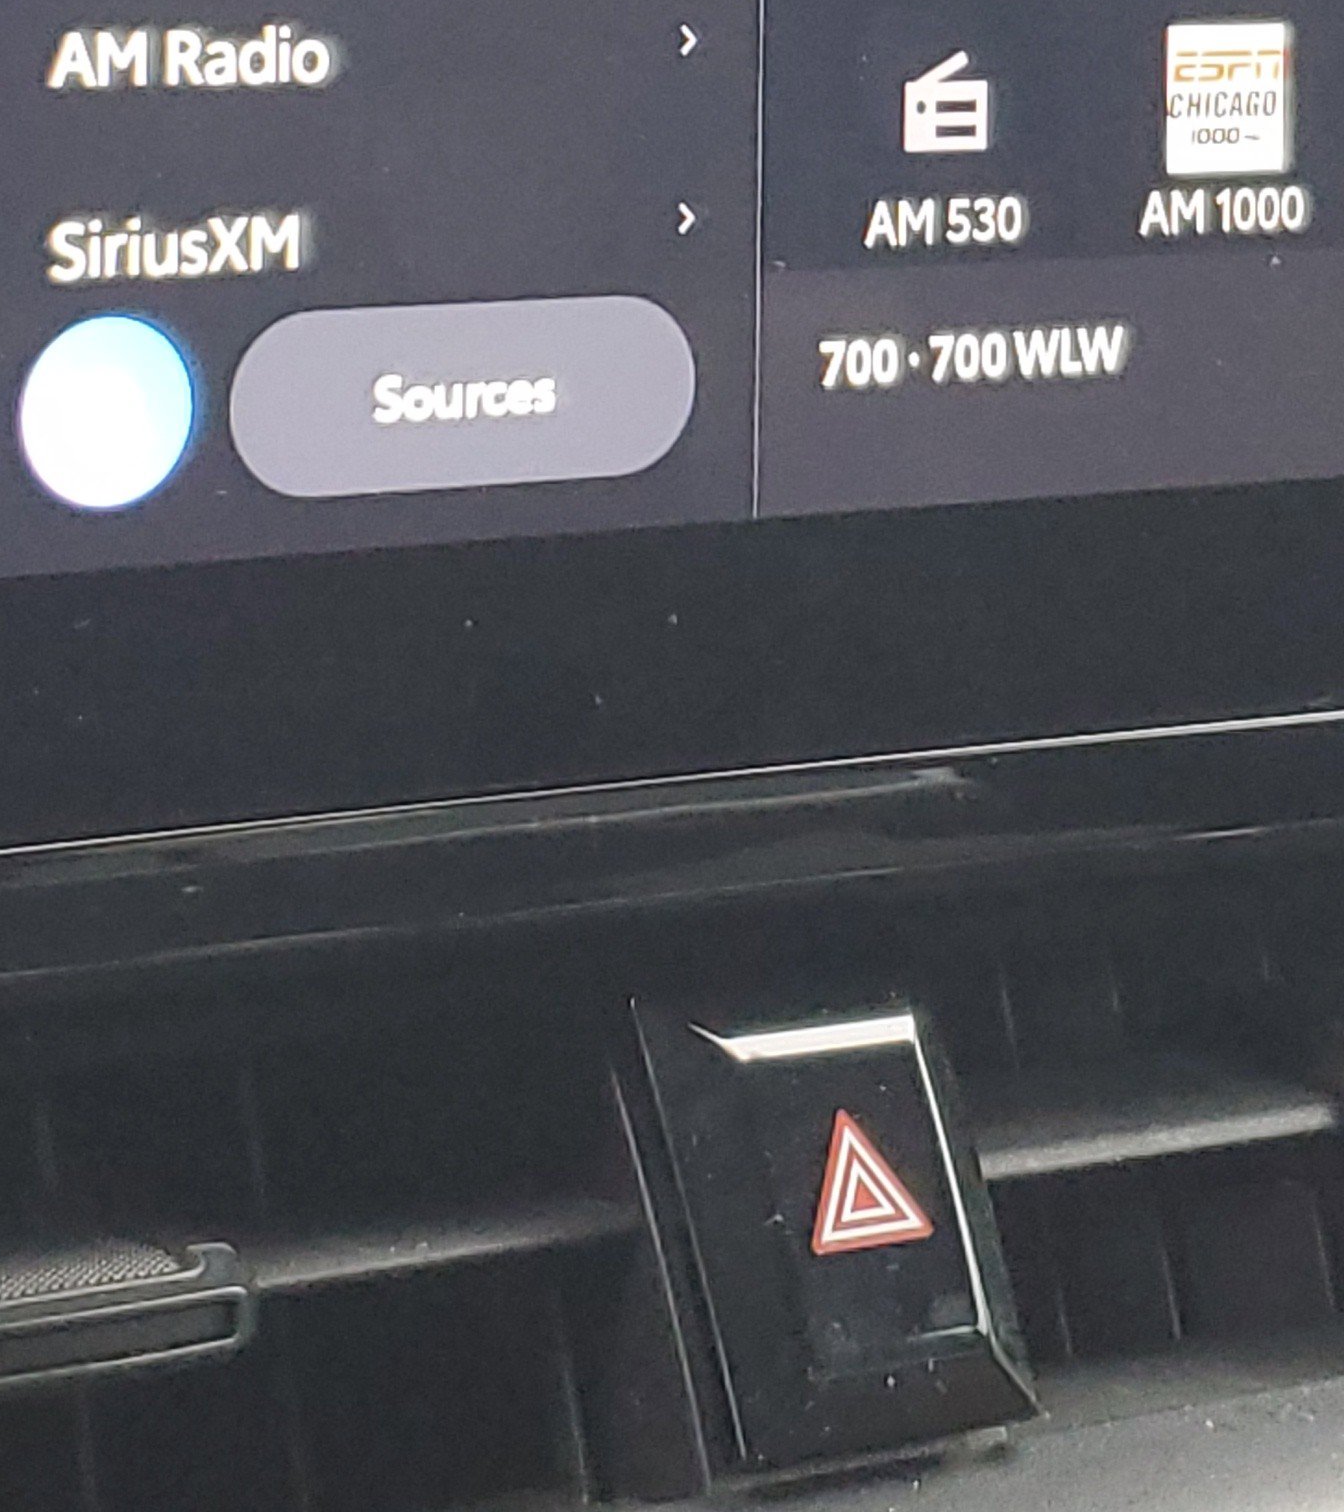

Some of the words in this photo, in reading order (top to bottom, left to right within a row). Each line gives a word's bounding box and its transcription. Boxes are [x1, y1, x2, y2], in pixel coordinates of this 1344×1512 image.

[47, 29, 150, 91] AM
[164, 23, 332, 89] Radio
[1173, 49, 1282, 82] ESPN
[1169, 90, 1277, 119] CHICAGO
[863, 197, 937, 250] AM
[945, 195, 1024, 245] 530
[1138, 188, 1207, 238] AM
[1214, 184, 1307, 235] 1000
[48, 213, 302, 284] SiriusXM
[1011, 324, 1127, 380] WLW
[372, 373, 558, 426] Sources
